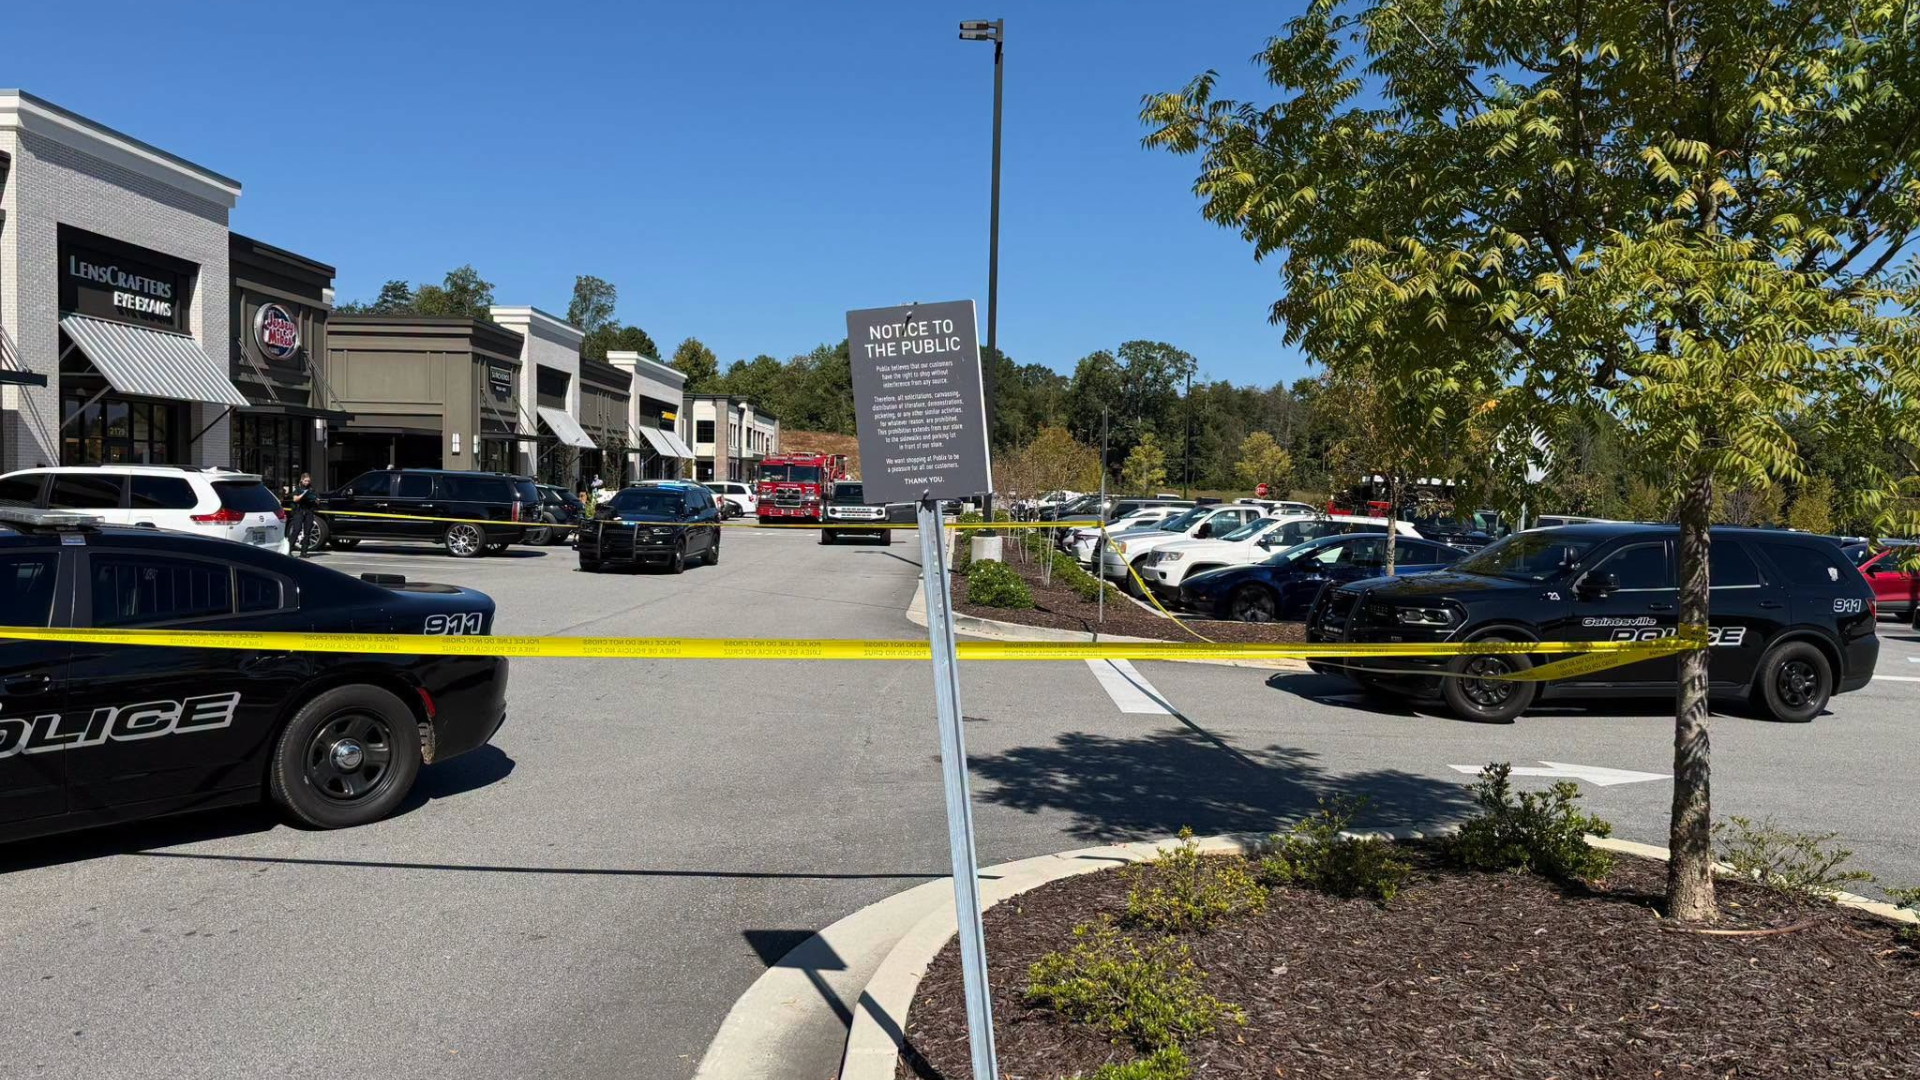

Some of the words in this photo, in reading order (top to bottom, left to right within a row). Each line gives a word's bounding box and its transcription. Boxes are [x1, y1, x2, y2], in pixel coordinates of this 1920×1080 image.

[114, 291, 135, 309] EYE
[136, 296, 172, 317] EXAMS
[263, 311, 295, 337] Jersey
[869, 321, 928, 340] NOTICE
[932, 319, 953, 334] TO
[864, 342, 897, 358] THE
[902, 336, 960, 355] PUBLIC
[1833, 598, 1861, 612] 911
[424, 612, 482, 635] 911
[1582, 617, 1656, 626] Gainesville
[0, 692, 241, 758] OLICE
